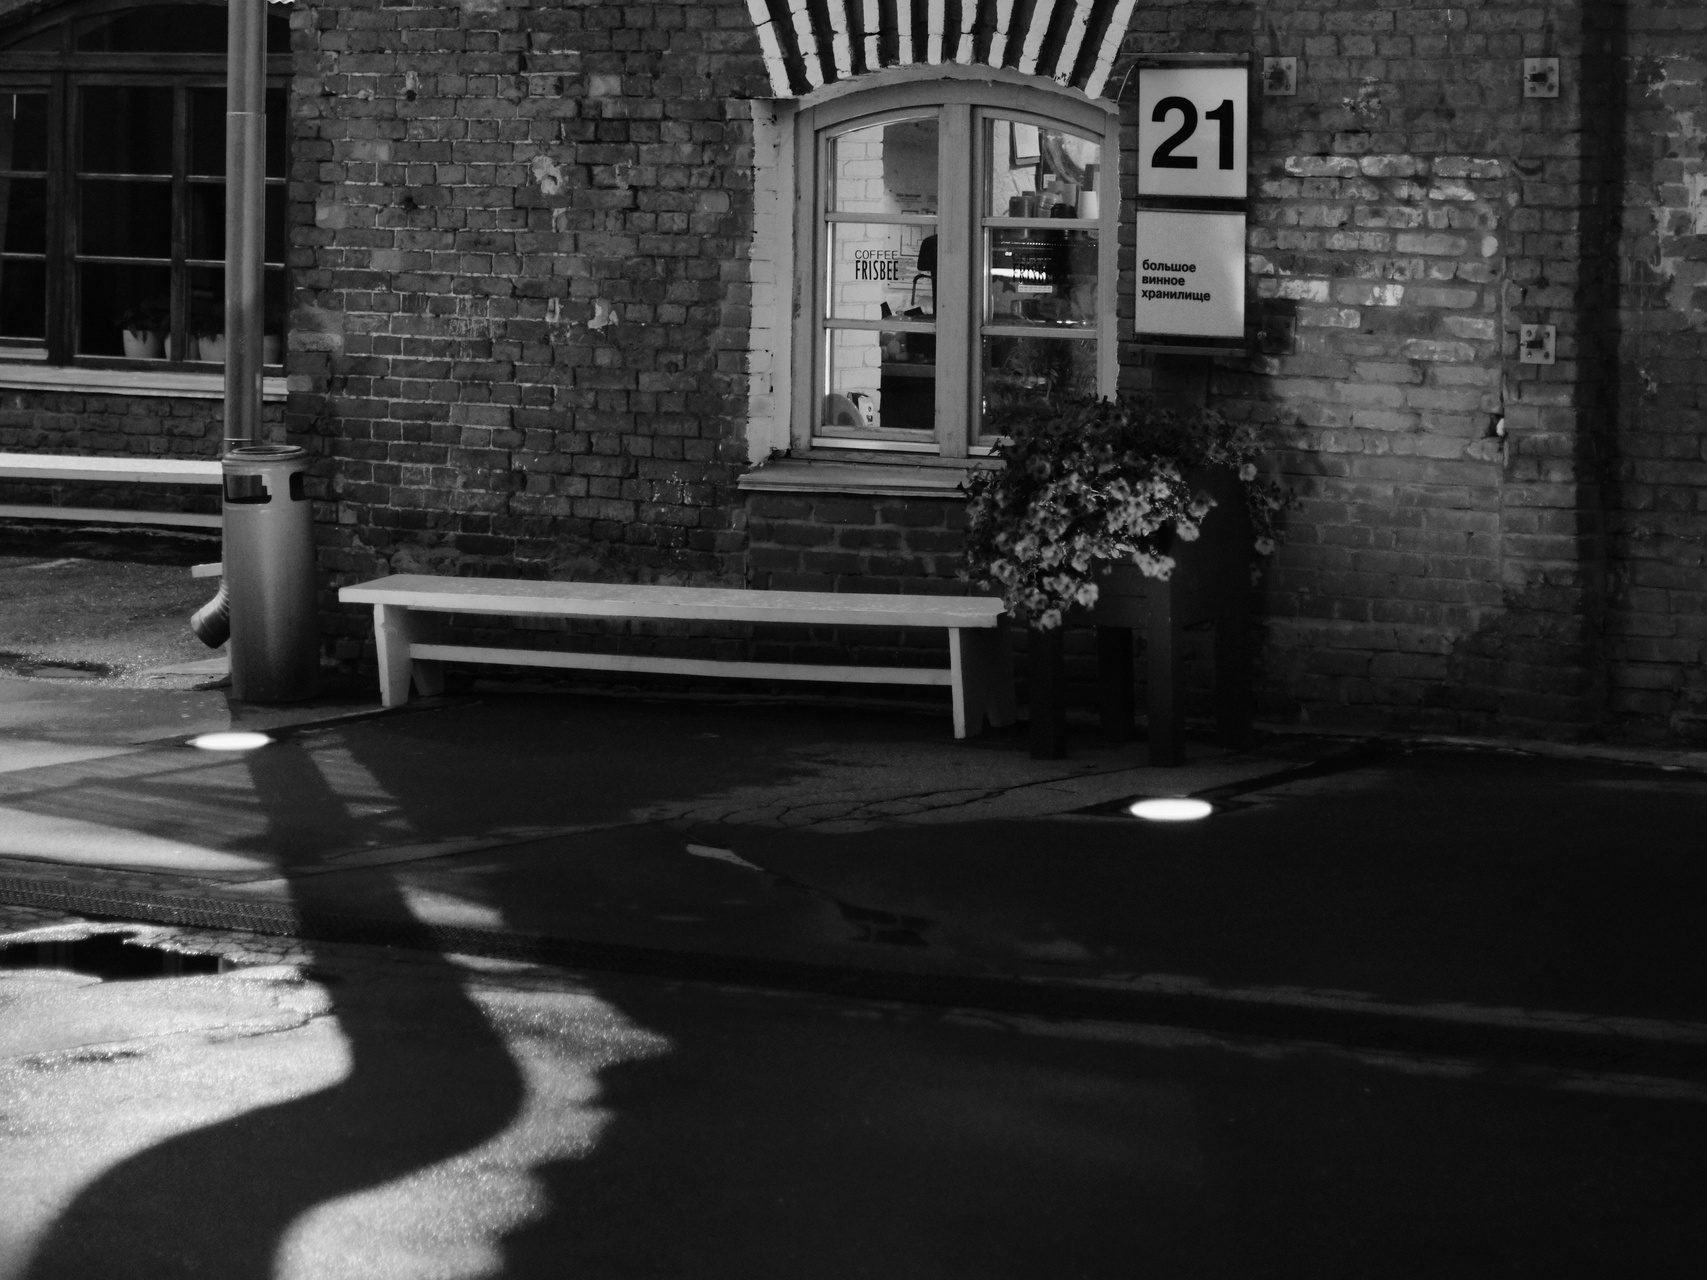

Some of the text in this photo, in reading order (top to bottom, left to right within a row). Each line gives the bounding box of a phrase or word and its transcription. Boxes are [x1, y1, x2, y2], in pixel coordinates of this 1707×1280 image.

[1151, 96, 1234, 170] 21
[855, 249, 898, 260] COFFEE
[855, 260, 899, 281] FRISBEE
[1142, 259, 1196, 273] большое
[1142, 276, 1185, 286] винное
[1141, 289, 1211, 303] хранилище
